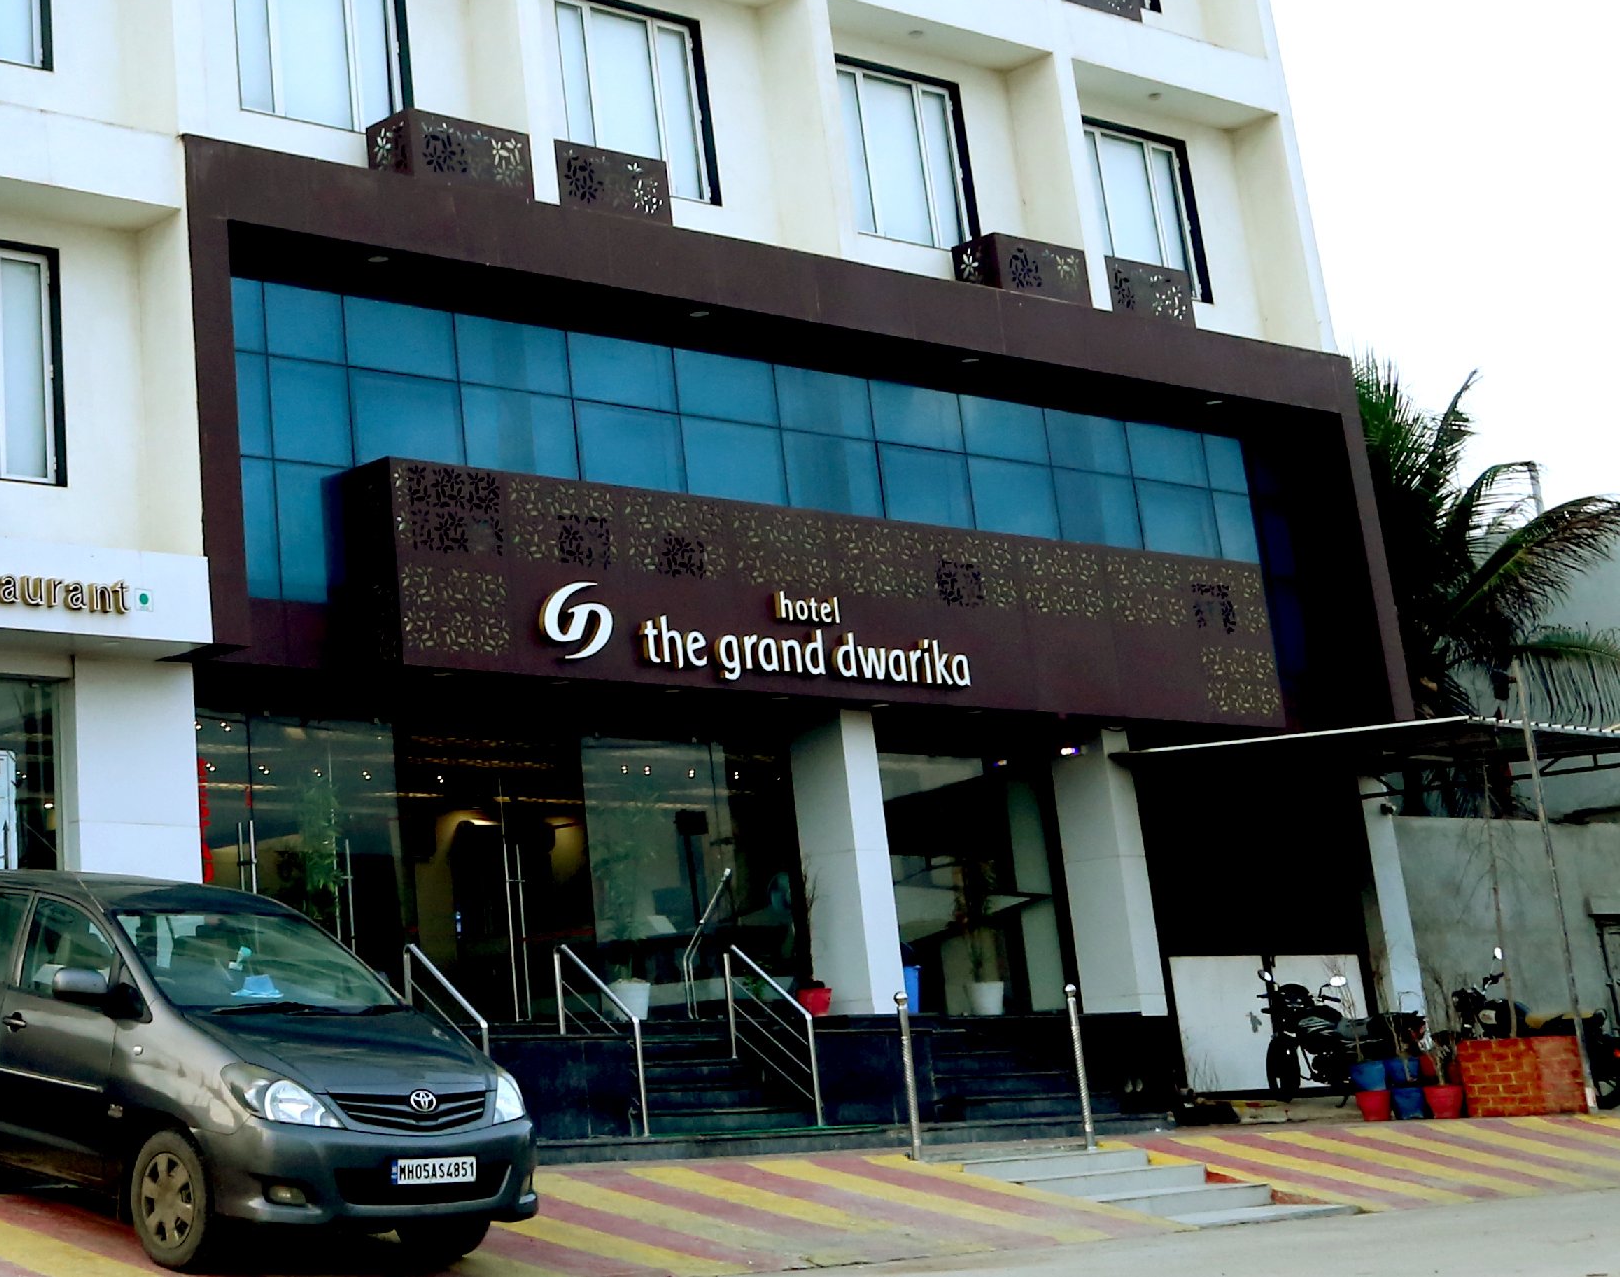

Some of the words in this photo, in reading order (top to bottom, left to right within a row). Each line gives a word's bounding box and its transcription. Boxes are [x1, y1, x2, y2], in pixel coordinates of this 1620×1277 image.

[775, 590, 841, 624] hotel
[640, 614, 708, 669] the
[714, 629, 827, 681] grand
[833, 631, 971, 686] dwarika
[399, 1162, 475, 1181] MH05AS4851
